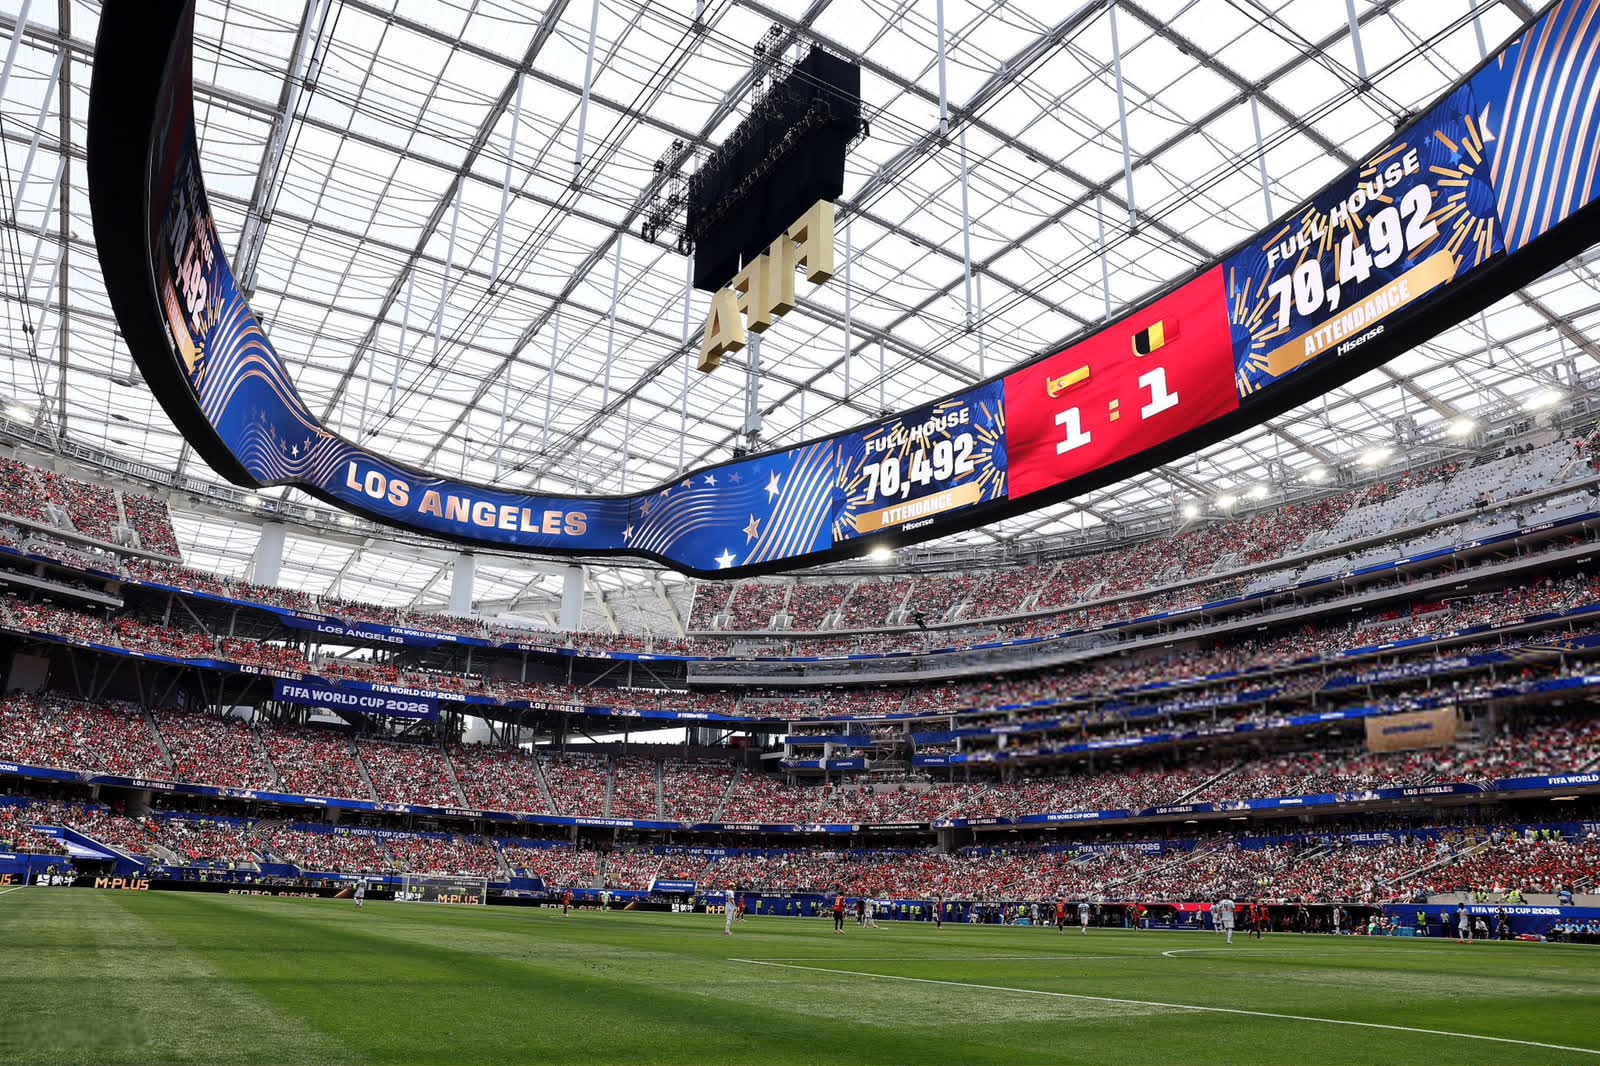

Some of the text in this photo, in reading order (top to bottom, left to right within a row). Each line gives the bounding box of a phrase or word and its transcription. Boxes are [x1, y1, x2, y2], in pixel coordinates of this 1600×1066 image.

[1266, 147, 1420, 271] FULL HOUSE
[1267, 184, 1440, 332] 70,492
[1304, 279, 1410, 357] ATTENDANCE
[1337, 325, 1385, 357] Hisense
[1055, 406, 1092, 456] 1
[1138, 367, 1179, 420] 1
[865, 407, 969, 455] FULL HOUSE
[863, 433, 974, 502] 70,492
[346, 461, 587, 536] LOS ANGELES
[881, 493, 953, 525] ATTENDANCE
[902, 518, 934, 532] Hisense
[317, 624, 404, 644] LOS ANGELES
[406, 629, 424, 637] WORLD
[437, 634, 457, 642] 2026
[240, 665, 303, 681] LOS ANGELES
[282, 685, 429, 714] FIFA WORLD CUP 2026
[372, 684, 466, 702] FIFA WORLD CUP 2026
[530, 702, 585, 713] LOS ANGELES
[133, 780, 175, 790] LOS ANGELES
[1419, 786, 1454, 794] ANGELES
[1549, 775, 1599, 785] FIFA WORLD
[1135, 843, 1160, 851] 2026
